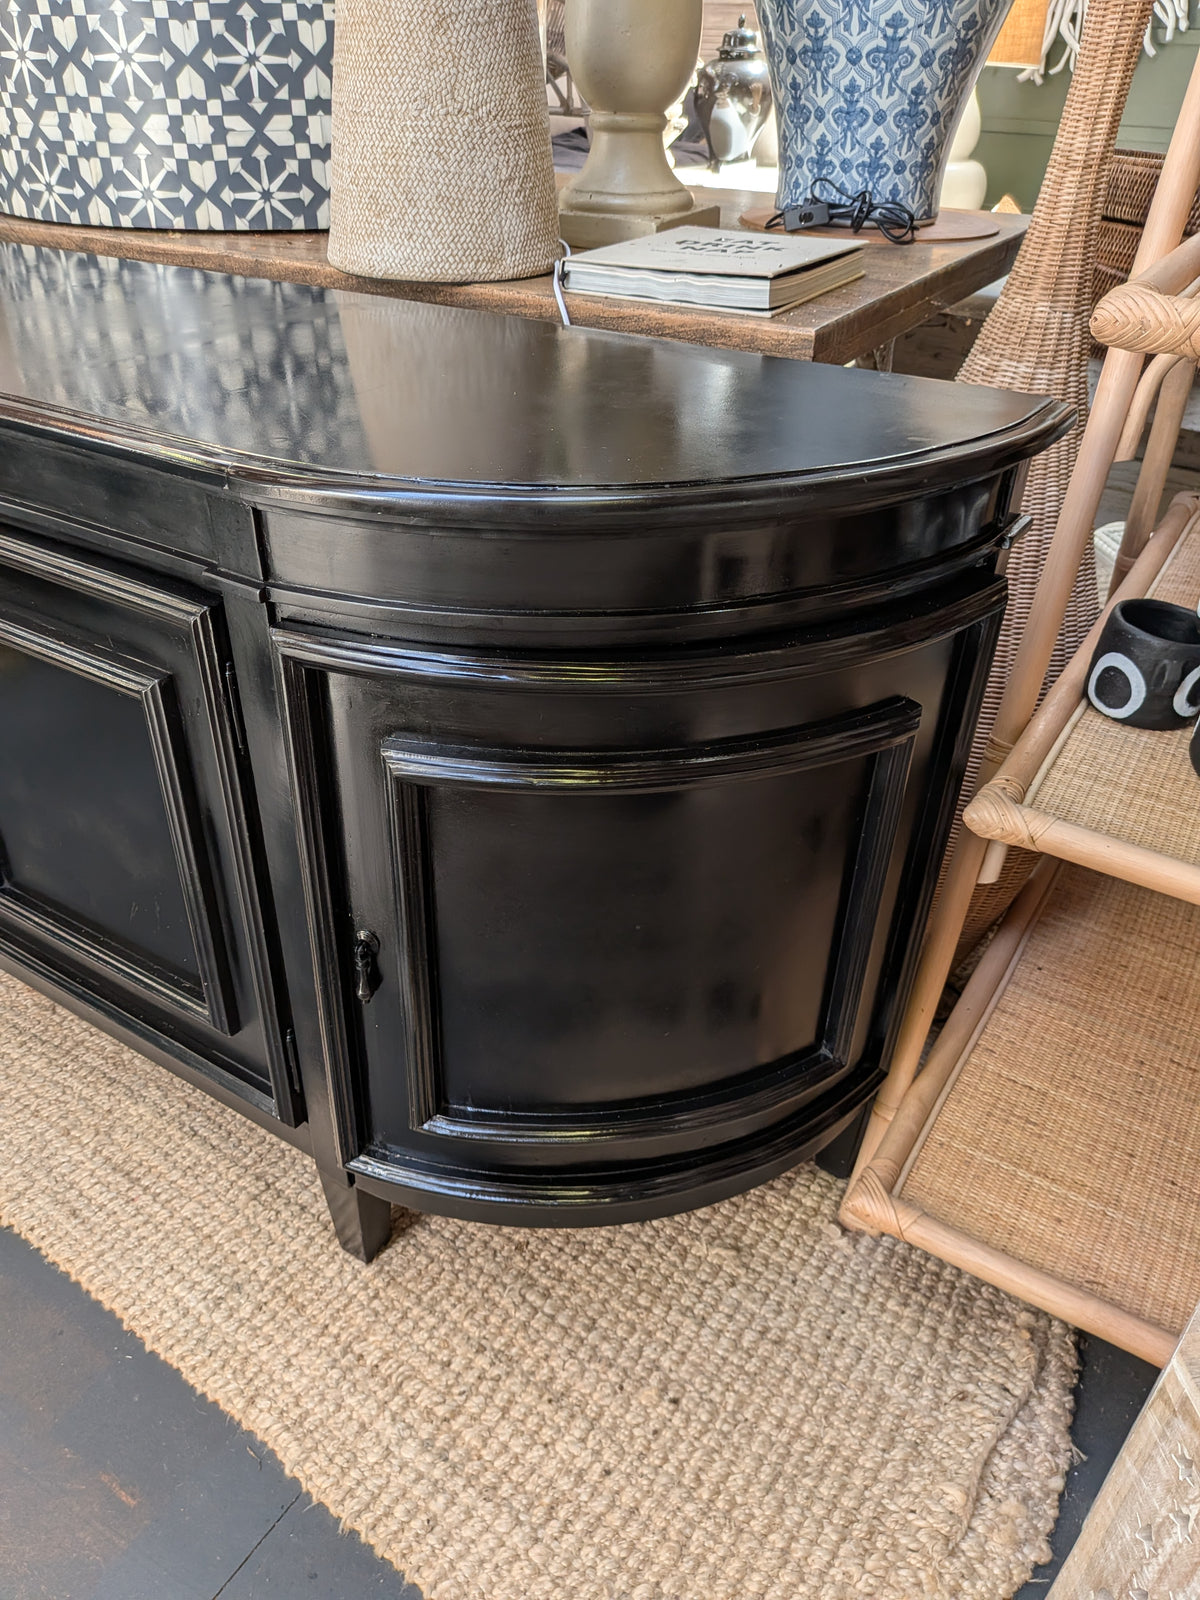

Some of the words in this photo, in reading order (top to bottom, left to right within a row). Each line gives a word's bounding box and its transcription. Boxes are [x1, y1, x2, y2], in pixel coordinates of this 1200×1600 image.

[676, 239, 787, 251] DRINK
[714, 237, 779, 245] EAT
[680, 246, 755, 254] NAP
